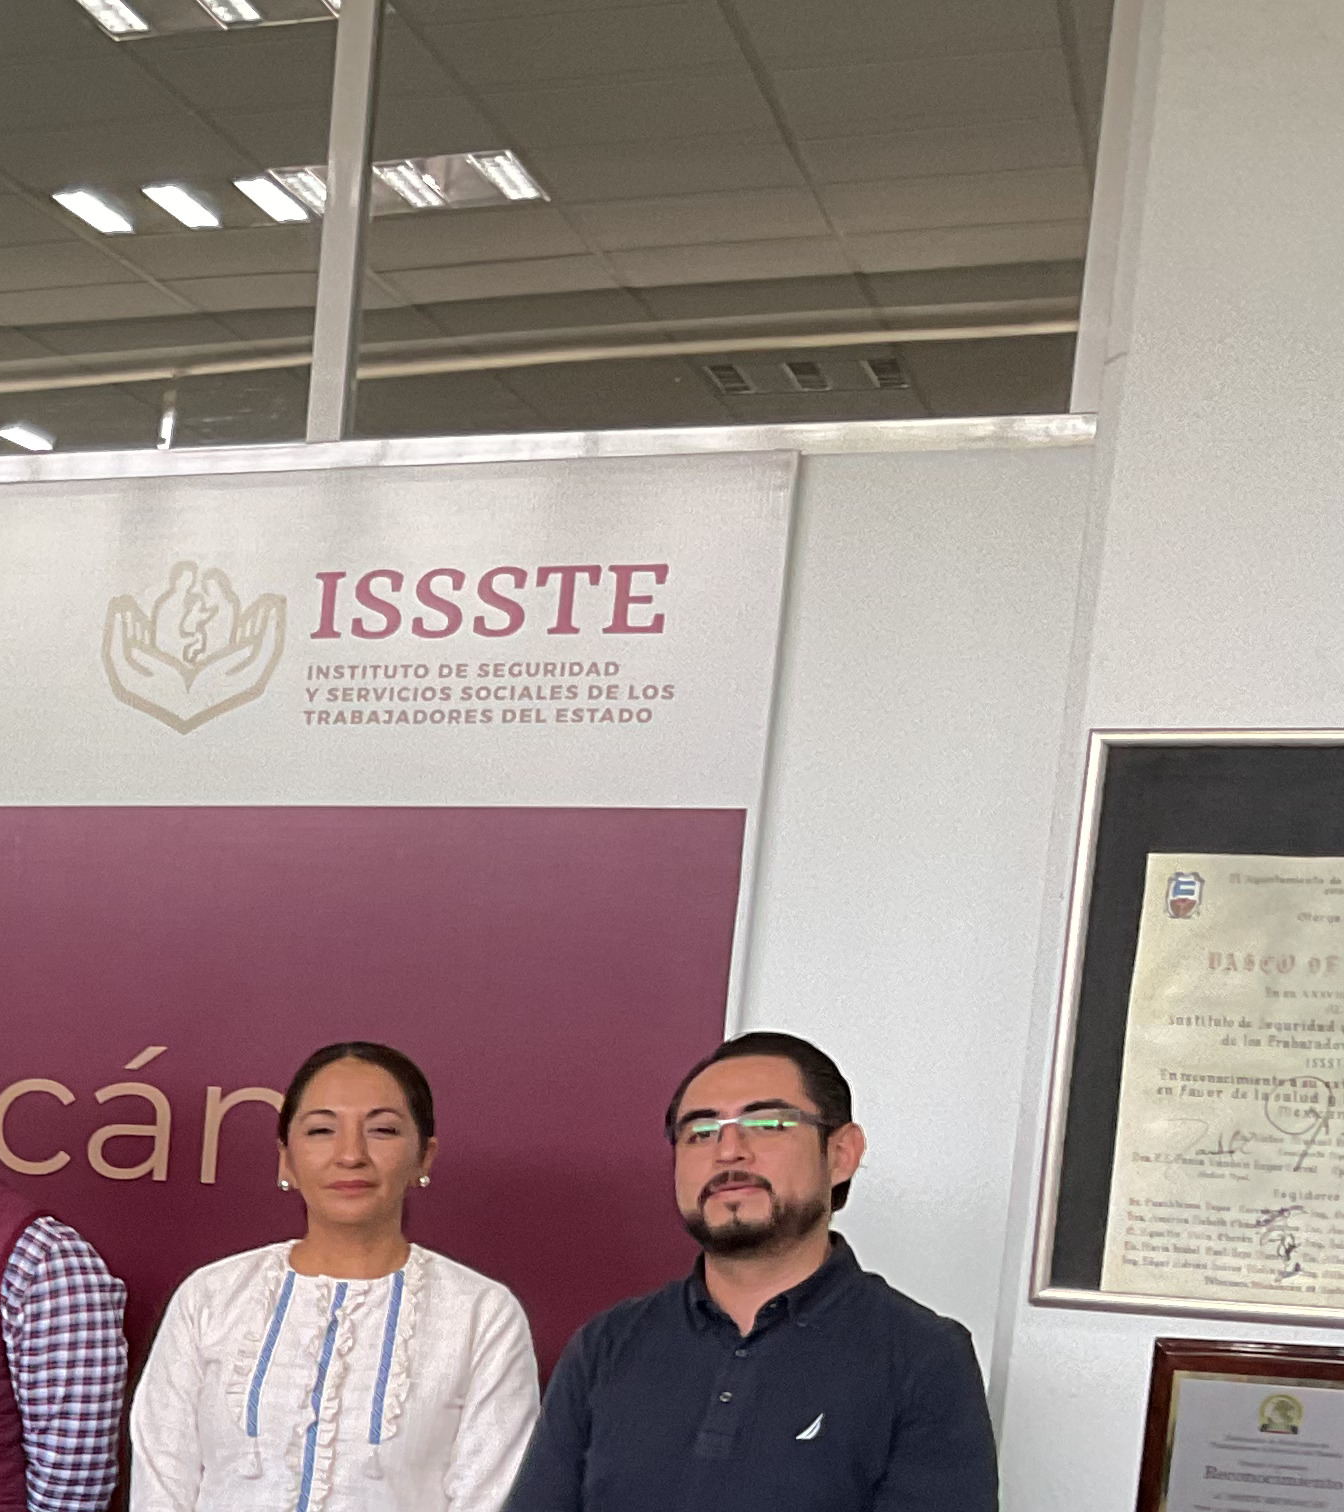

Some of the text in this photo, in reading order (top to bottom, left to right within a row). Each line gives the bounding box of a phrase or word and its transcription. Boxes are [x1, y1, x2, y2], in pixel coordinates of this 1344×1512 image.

[310, 563, 670, 640] ISSSTE
[307, 661, 620, 680] INSTITUTO DE SEGURIDAD
[305, 683, 676, 703] Y SERVICIOS SOCIALES DE LOS
[303, 708, 654, 726] TRABAJADORES DEL ESTADO
